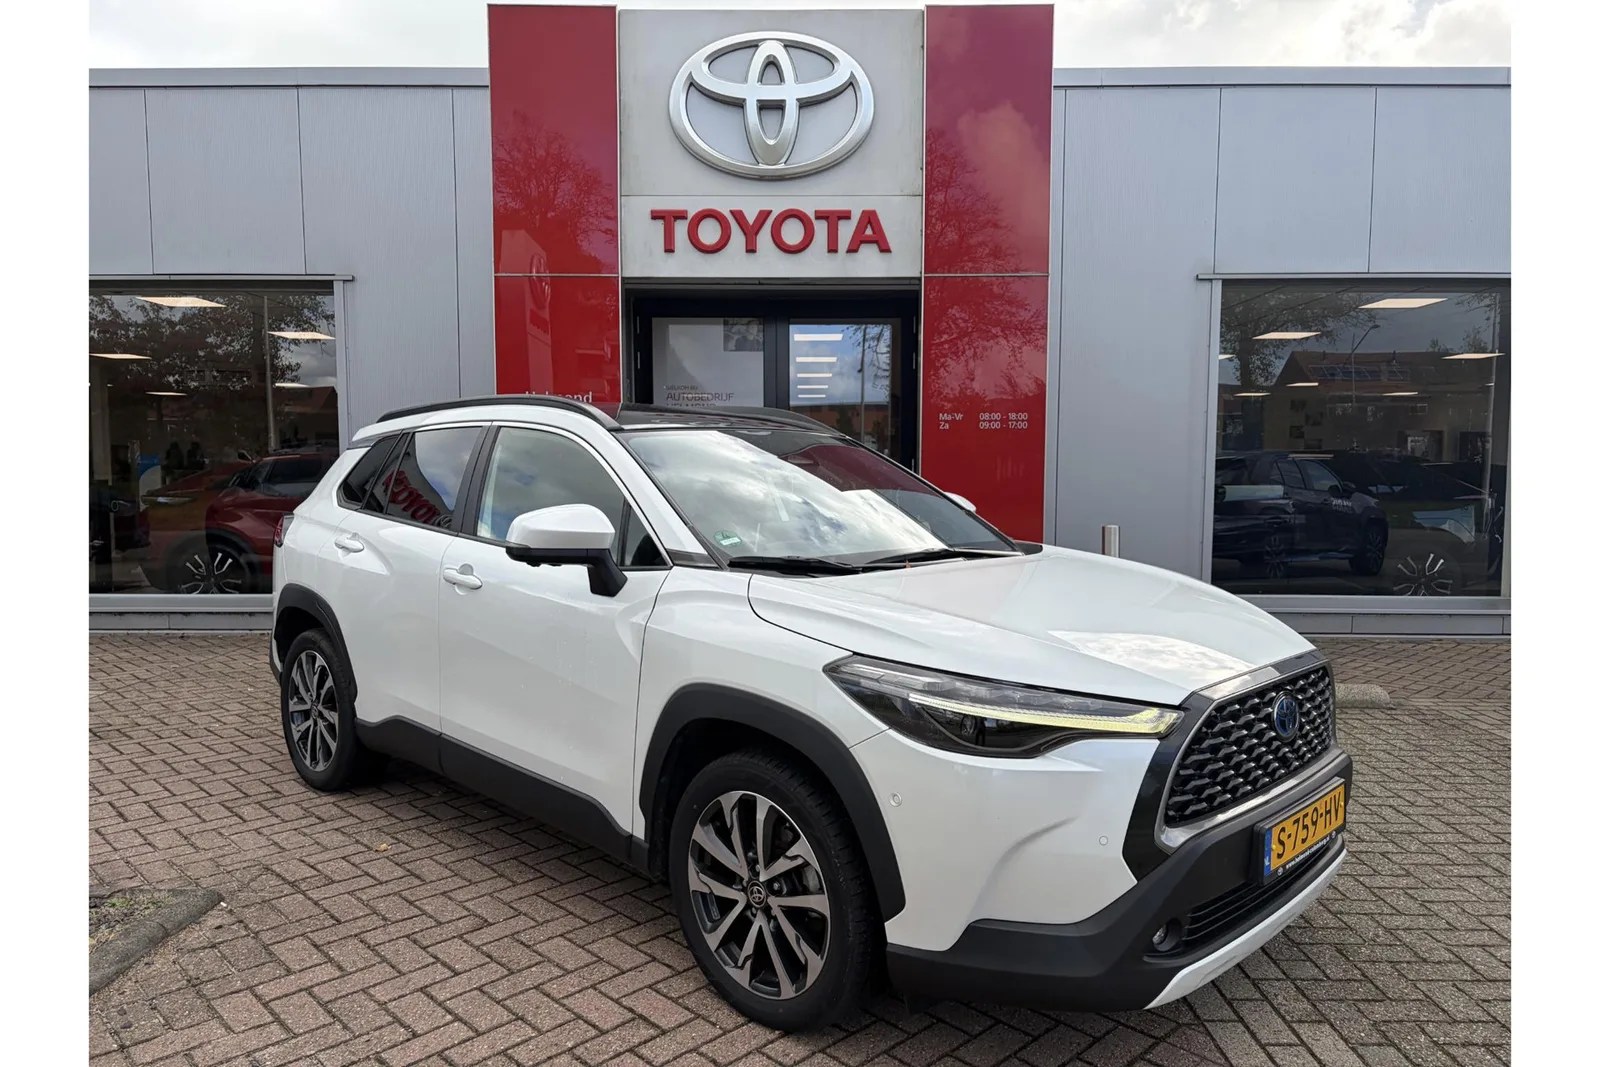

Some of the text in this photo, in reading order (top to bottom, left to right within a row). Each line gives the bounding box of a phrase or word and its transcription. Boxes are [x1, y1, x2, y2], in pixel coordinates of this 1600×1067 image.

[650, 208, 892, 254] TOYOTA
[666, 392, 734, 401] AUTOBEDRIJF
[939, 412, 964, 421] Ma-Vr
[979, 412, 1001, 421] 08:00
[1008, 412, 1028, 421] 18:00
[939, 421, 950, 430] Za
[979, 421, 1001, 429] 09:00
[1008, 421, 1028, 429] 17:00
[1277, 792, 1341, 859] S-759-HV
